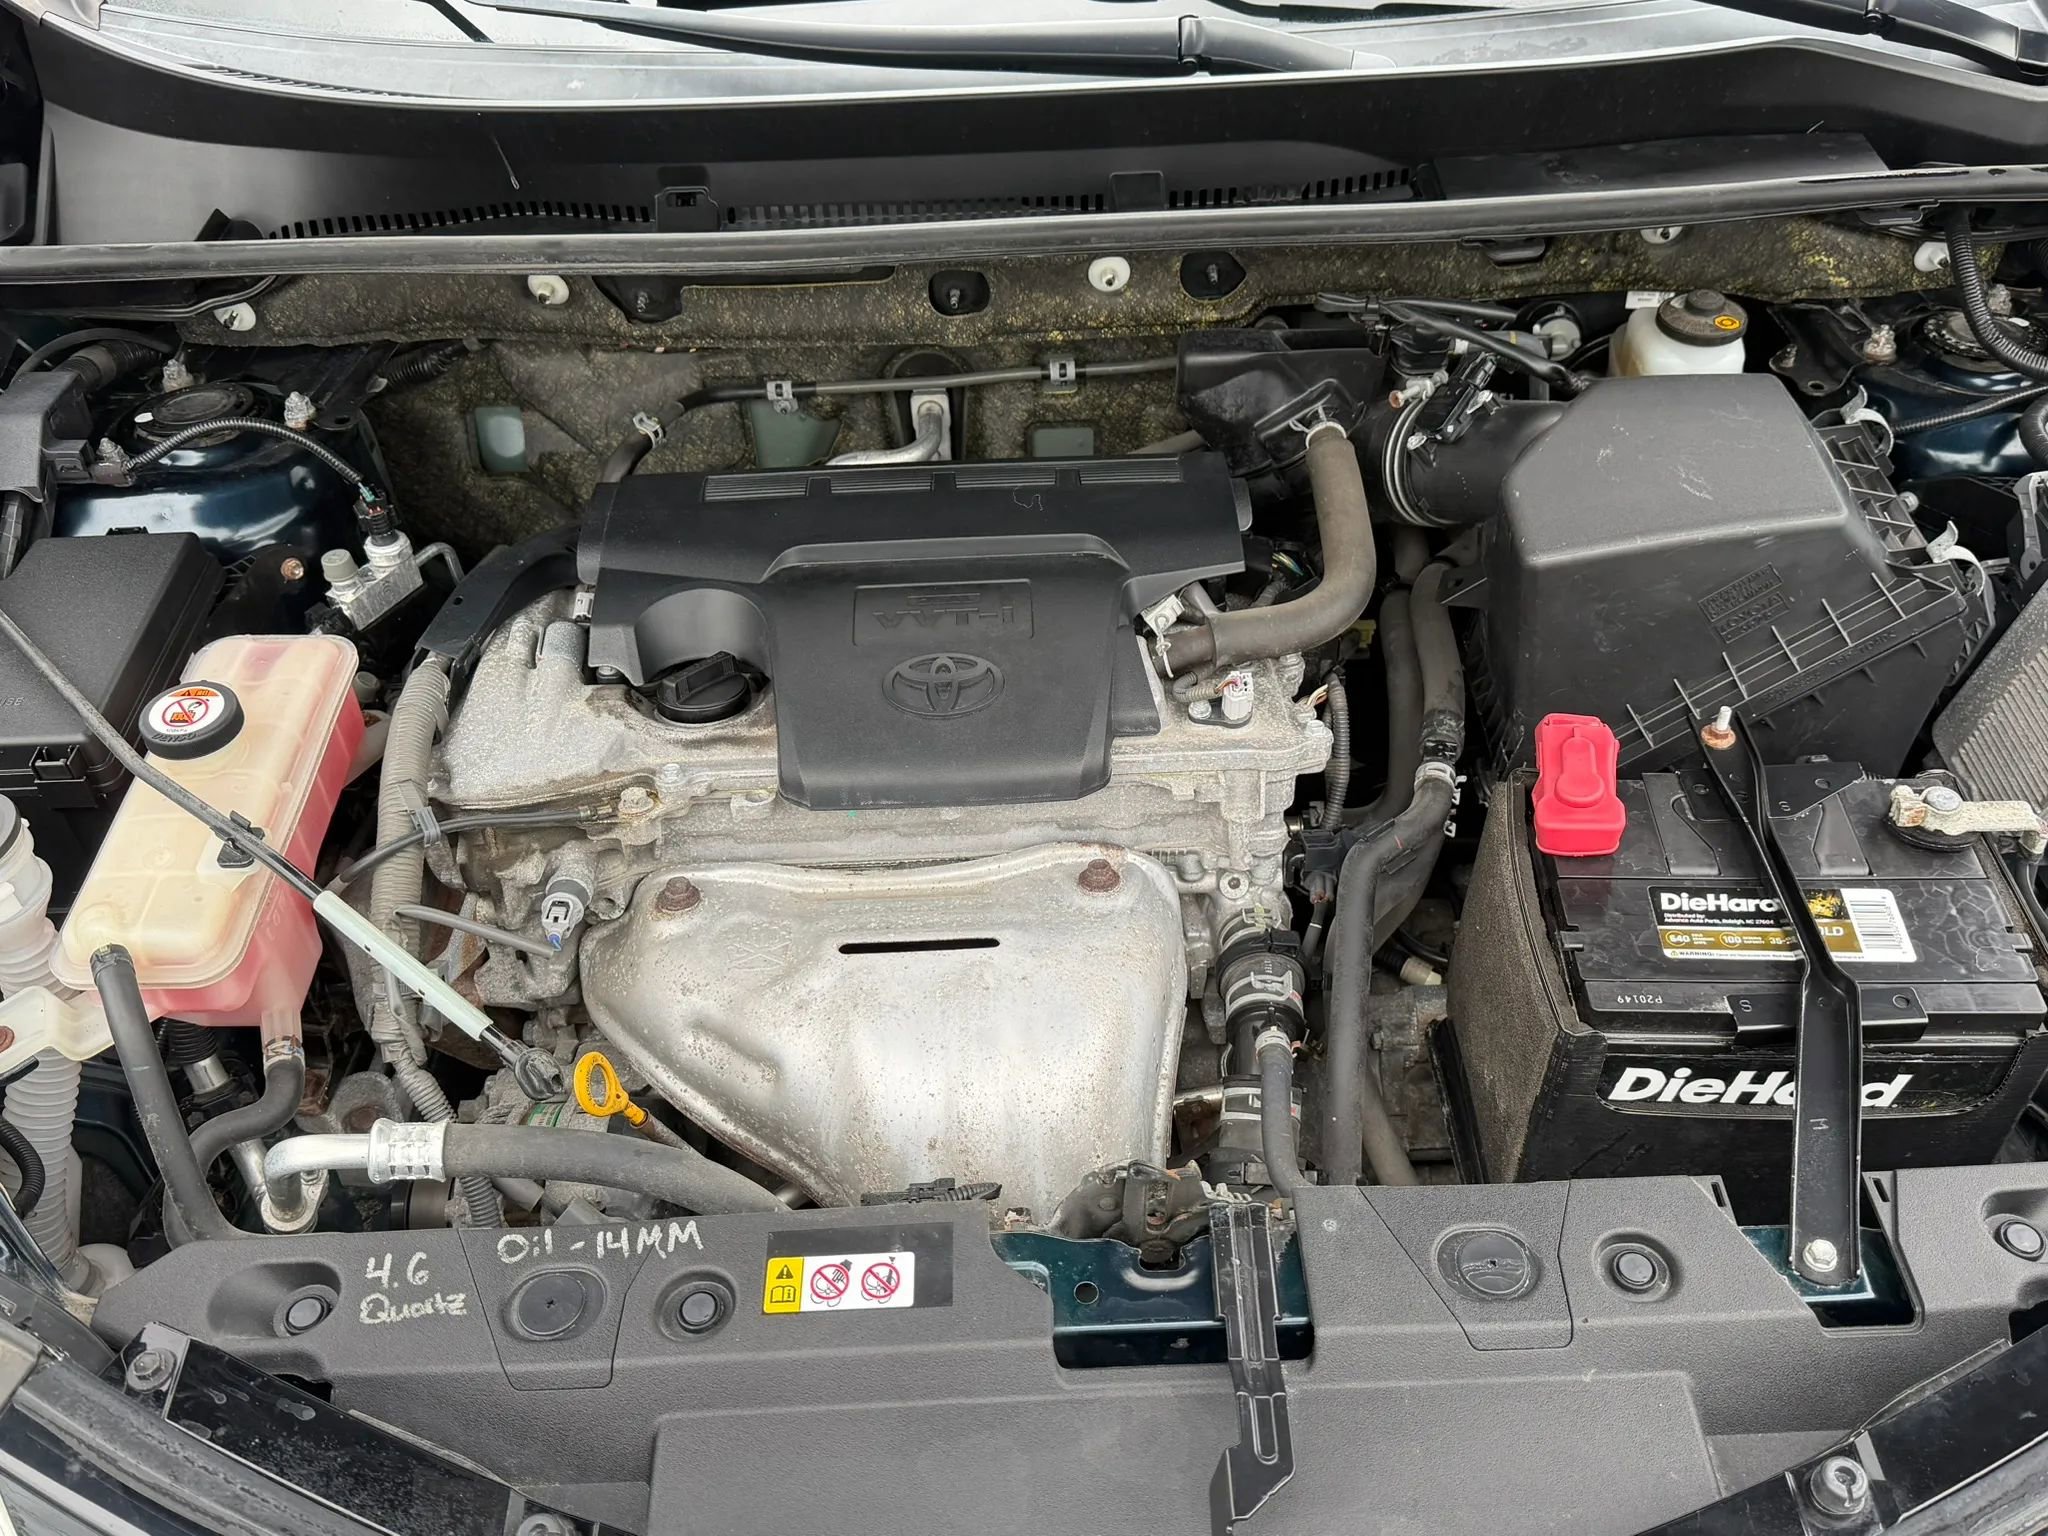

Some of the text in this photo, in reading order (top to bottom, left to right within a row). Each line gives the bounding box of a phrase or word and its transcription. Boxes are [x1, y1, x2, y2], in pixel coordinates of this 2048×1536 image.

[1819, 926, 1844, 936] LD
[1617, 994, 1664, 1004] P20149
[1608, 1067, 1914, 1106] DieHd
[497, 1228, 552, 1264] Oil
[596, 1220, 704, 1259] 14MM
[365, 1252, 430, 1289] 4.6
